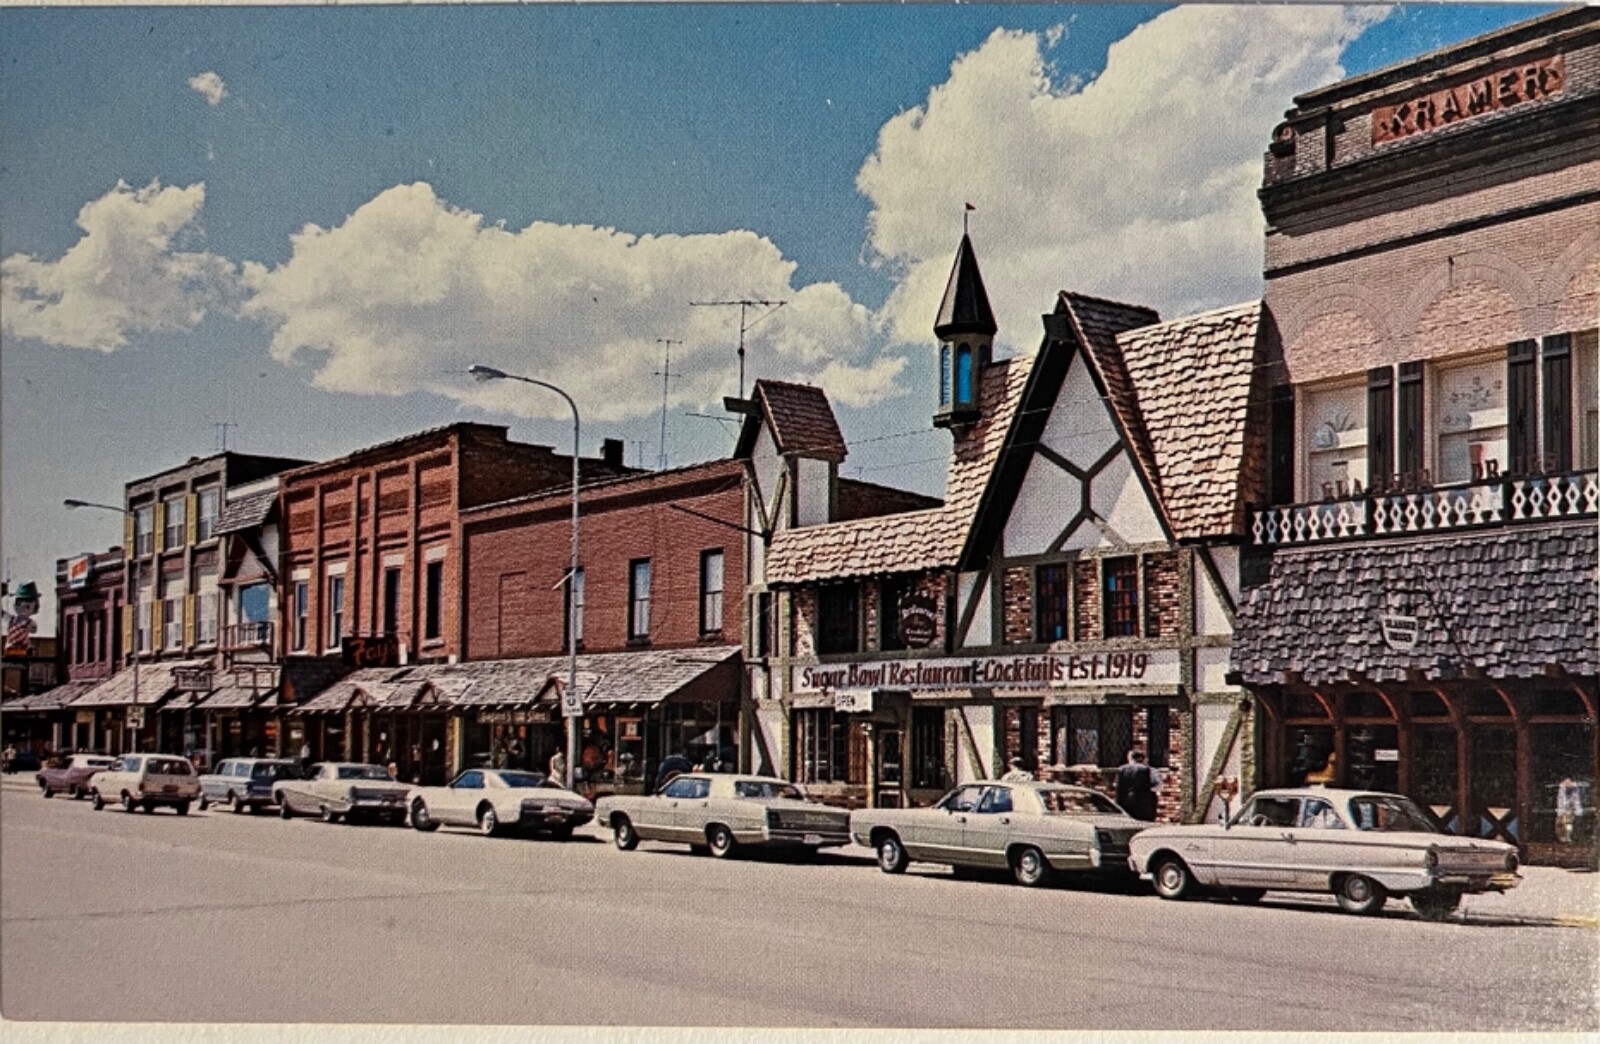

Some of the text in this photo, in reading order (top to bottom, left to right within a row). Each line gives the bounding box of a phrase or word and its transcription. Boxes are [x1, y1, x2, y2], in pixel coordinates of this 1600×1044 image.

[1388, 65, 1554, 135] KRAMER
[802, 667, 846, 696] Sugar
[849, 662, 886, 688] Bowl
